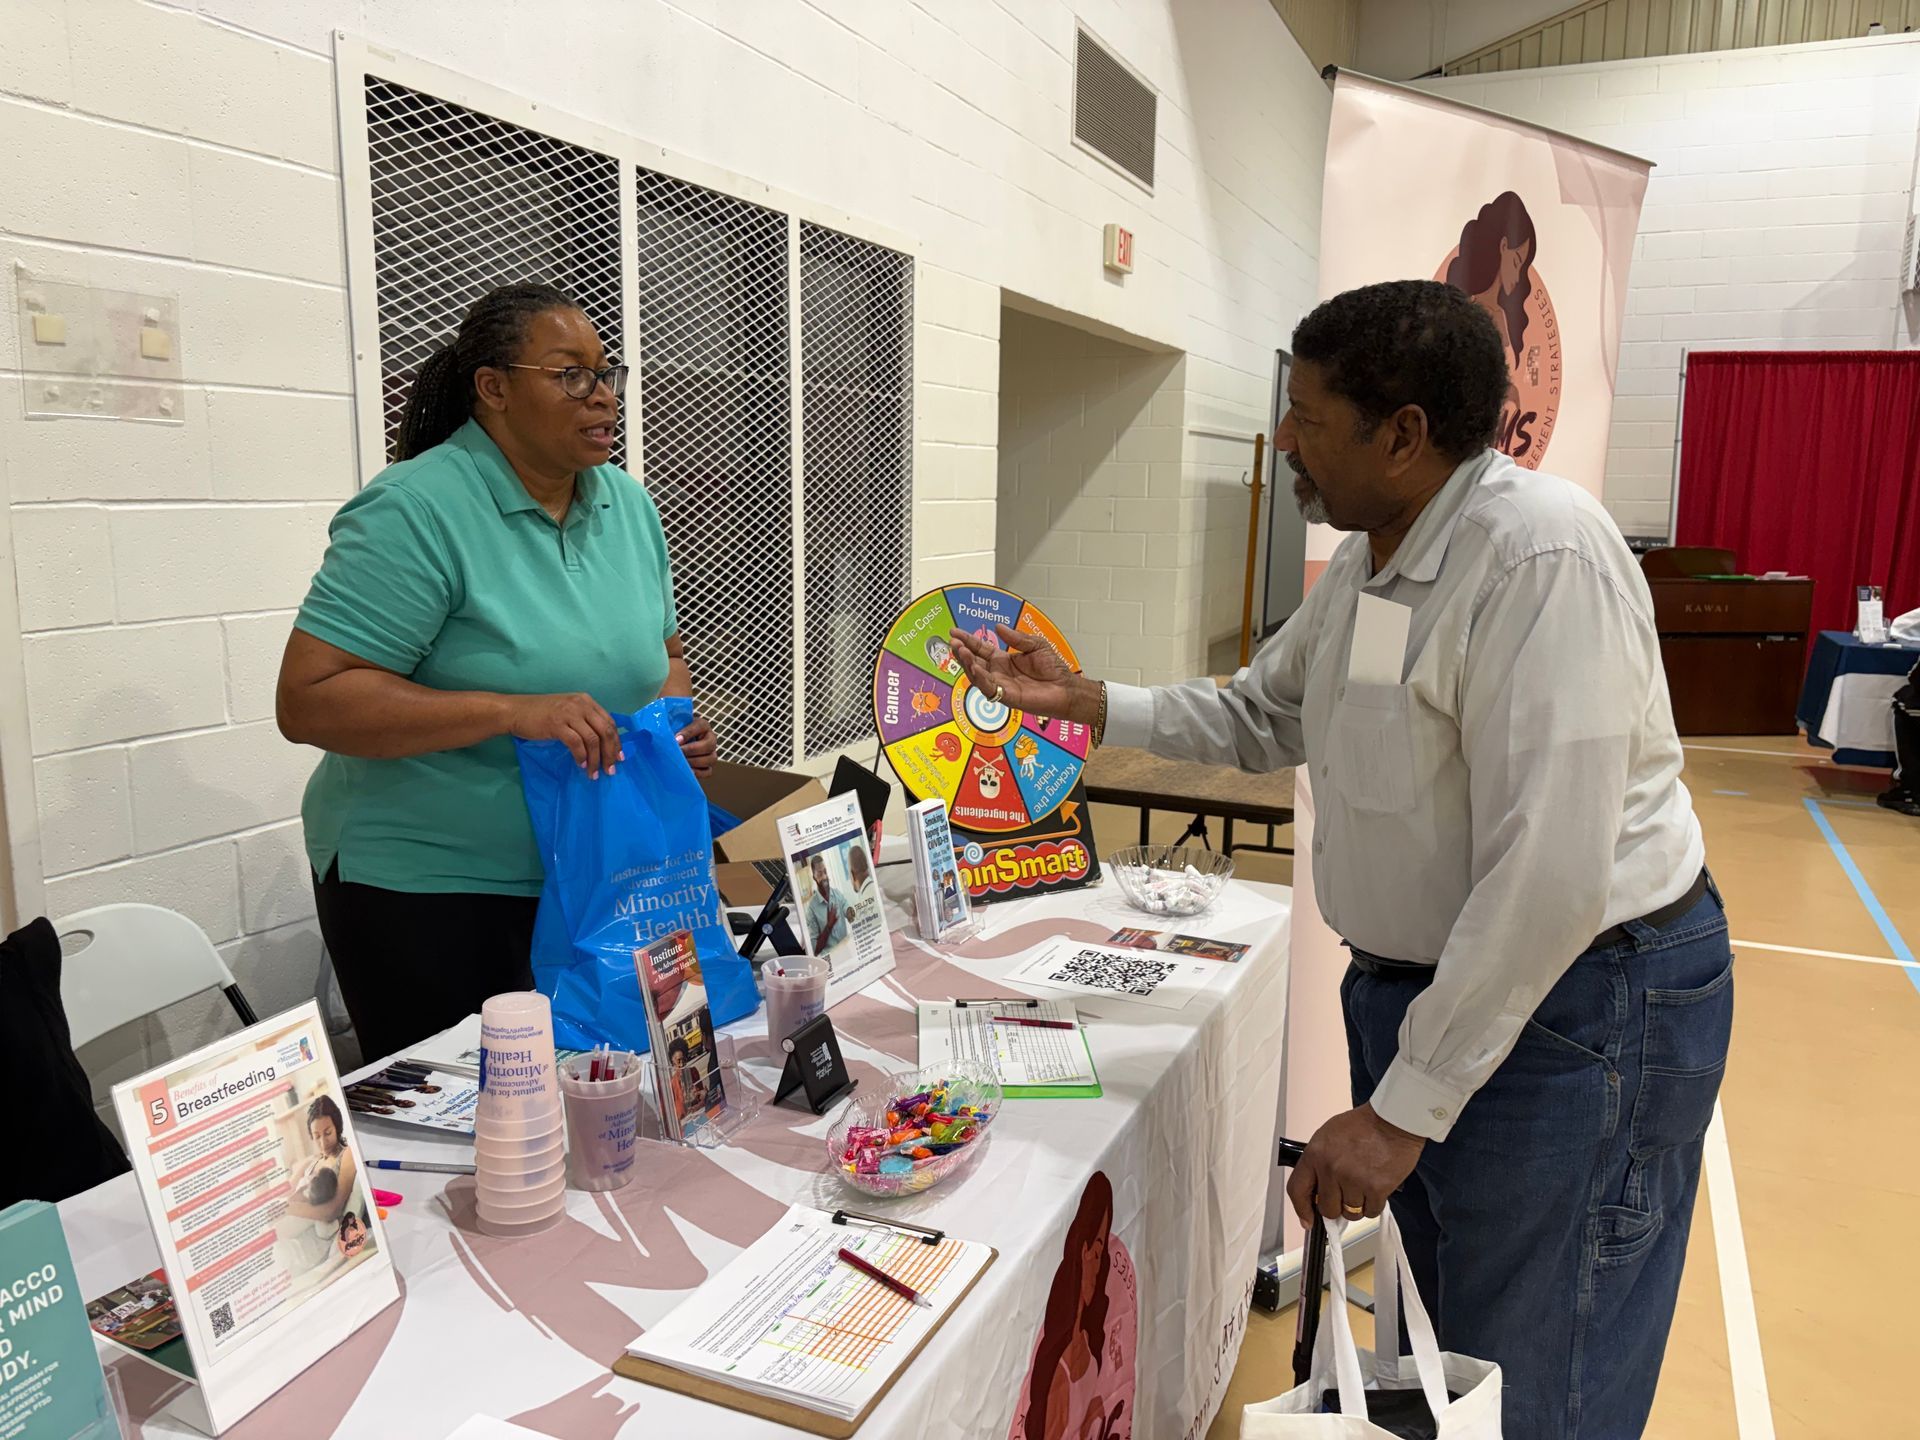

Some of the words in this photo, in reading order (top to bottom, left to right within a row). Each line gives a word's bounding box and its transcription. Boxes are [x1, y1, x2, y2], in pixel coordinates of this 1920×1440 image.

[1534, 288, 1561, 395] STRATEGIES
[1526, 406, 1555, 469] GEMENT
[971, 593, 1000, 610] Lung
[1685, 604, 1730, 613] KAWAI
[898, 628, 918, 647] The
[914, 603, 943, 630] Costs
[958, 603, 1011, 625] Problems
[884, 670, 901, 725] Cancer
[1033, 764, 1059, 791] Habit
[1045, 762, 1077, 797] Kicking
[955, 806, 1008, 822] Ingredients
[1033, 795, 1050, 813] the
[1010, 811, 1026, 823] The
[664, 855, 681, 869] for
[684, 849, 704, 862] the
[958, 844, 1087, 889] pinSmart
[613, 882, 711, 917] Minority
[632, 908, 711, 942] Health
[649, 943, 683, 966] Institute
[490, 1049, 532, 1064] Health
[487, 1062, 542, 1080] Minority
[173, 1079, 207, 1100] Benefits
[177, 1066, 276, 1118] Breastfeeding
[490, 1078, 540, 1088] Advancement
[498, 1089, 511, 1098] for
[511, 1084, 546, 1097] Institute
[150, 1097, 169, 1126] 5
[607, 1124, 636, 1141] Mino
[616, 1138, 636, 1153] Hea
[0, 1263, 57, 1309] ACCO
[9, 1284, 64, 1327] MIND
[0, 1350, 38, 1386] DY.
